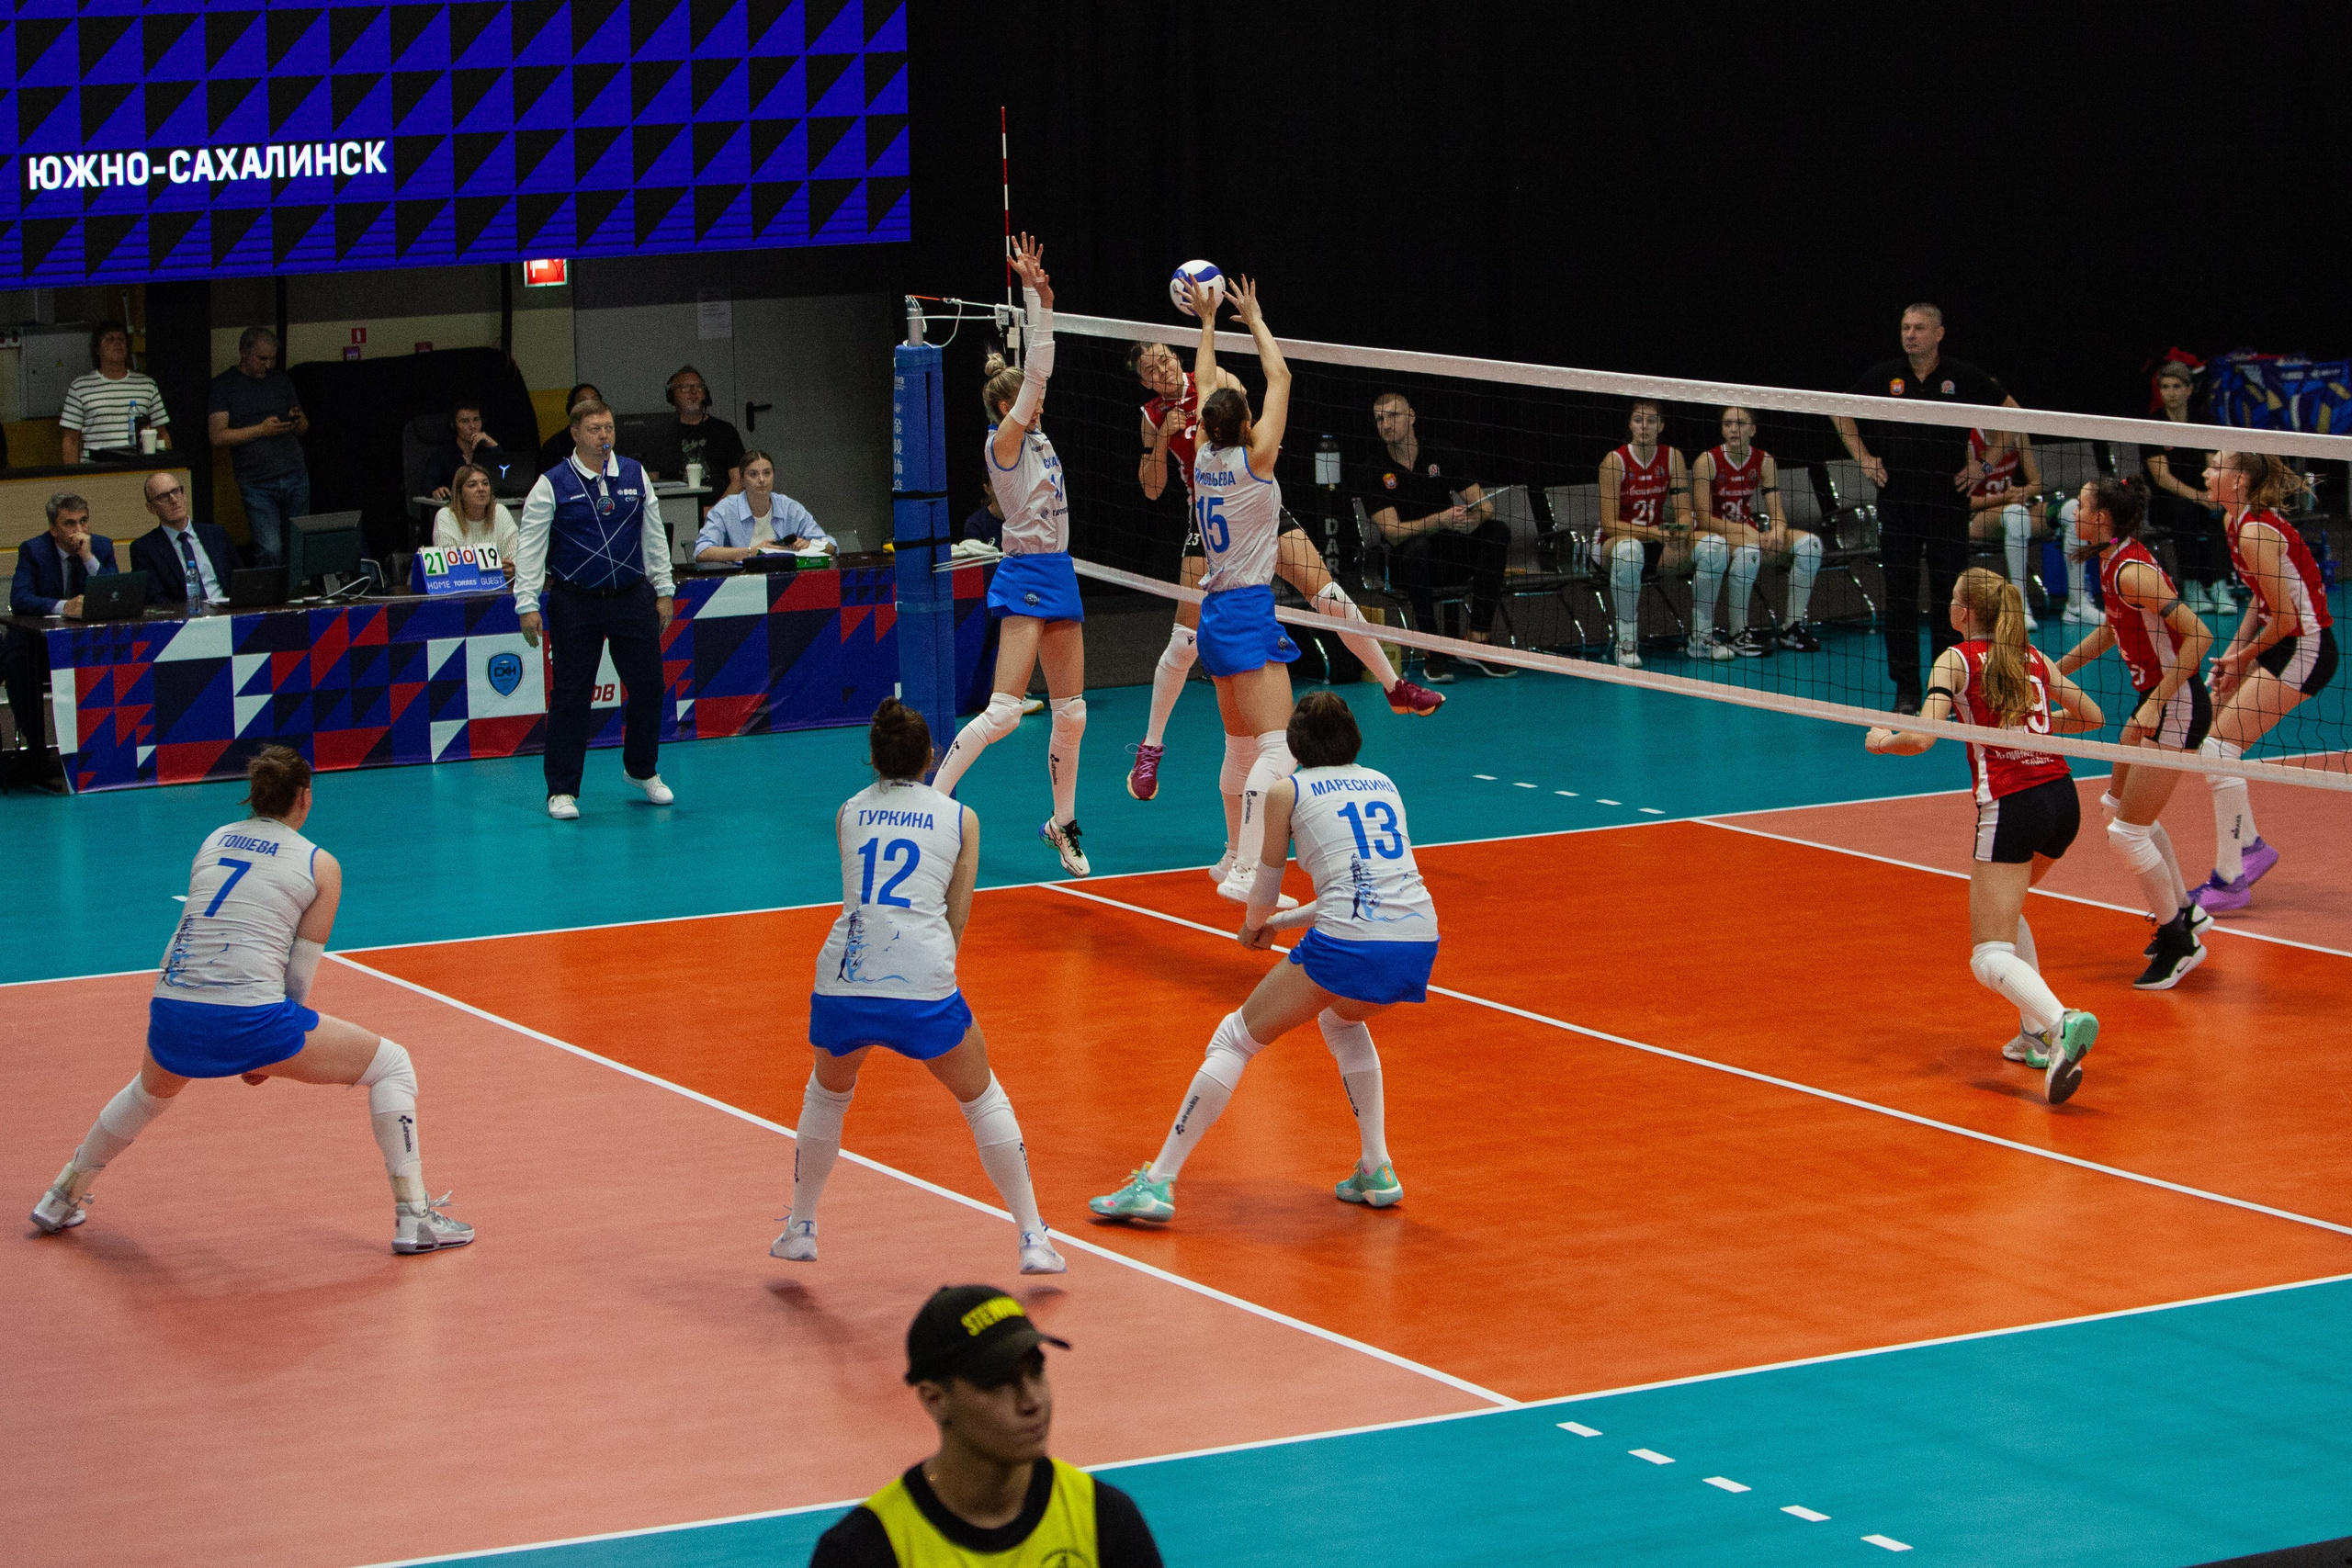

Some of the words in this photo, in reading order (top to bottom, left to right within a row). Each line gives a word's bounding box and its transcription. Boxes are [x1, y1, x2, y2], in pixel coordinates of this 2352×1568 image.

[29, 141, 387, 190] ЮЖНО-САХАЛИНСК
[1196, 496, 1230, 553] 15
[424, 552, 445, 574] 21
[447, 551, 458, 564] 0
[463, 549, 474, 563] 0
[479, 547, 497, 568] 19
[427, 580, 451, 590] HOME
[481, 576, 503, 585] GUEST
[1310, 779, 1397, 796] МАРЕСКИНА
[858, 809, 933, 830] ТУРКИНА
[1337, 800, 1404, 860] 13
[217, 834, 279, 857] ГОШЕВА
[204, 857, 253, 917] 7
[857, 837, 921, 908] 12
